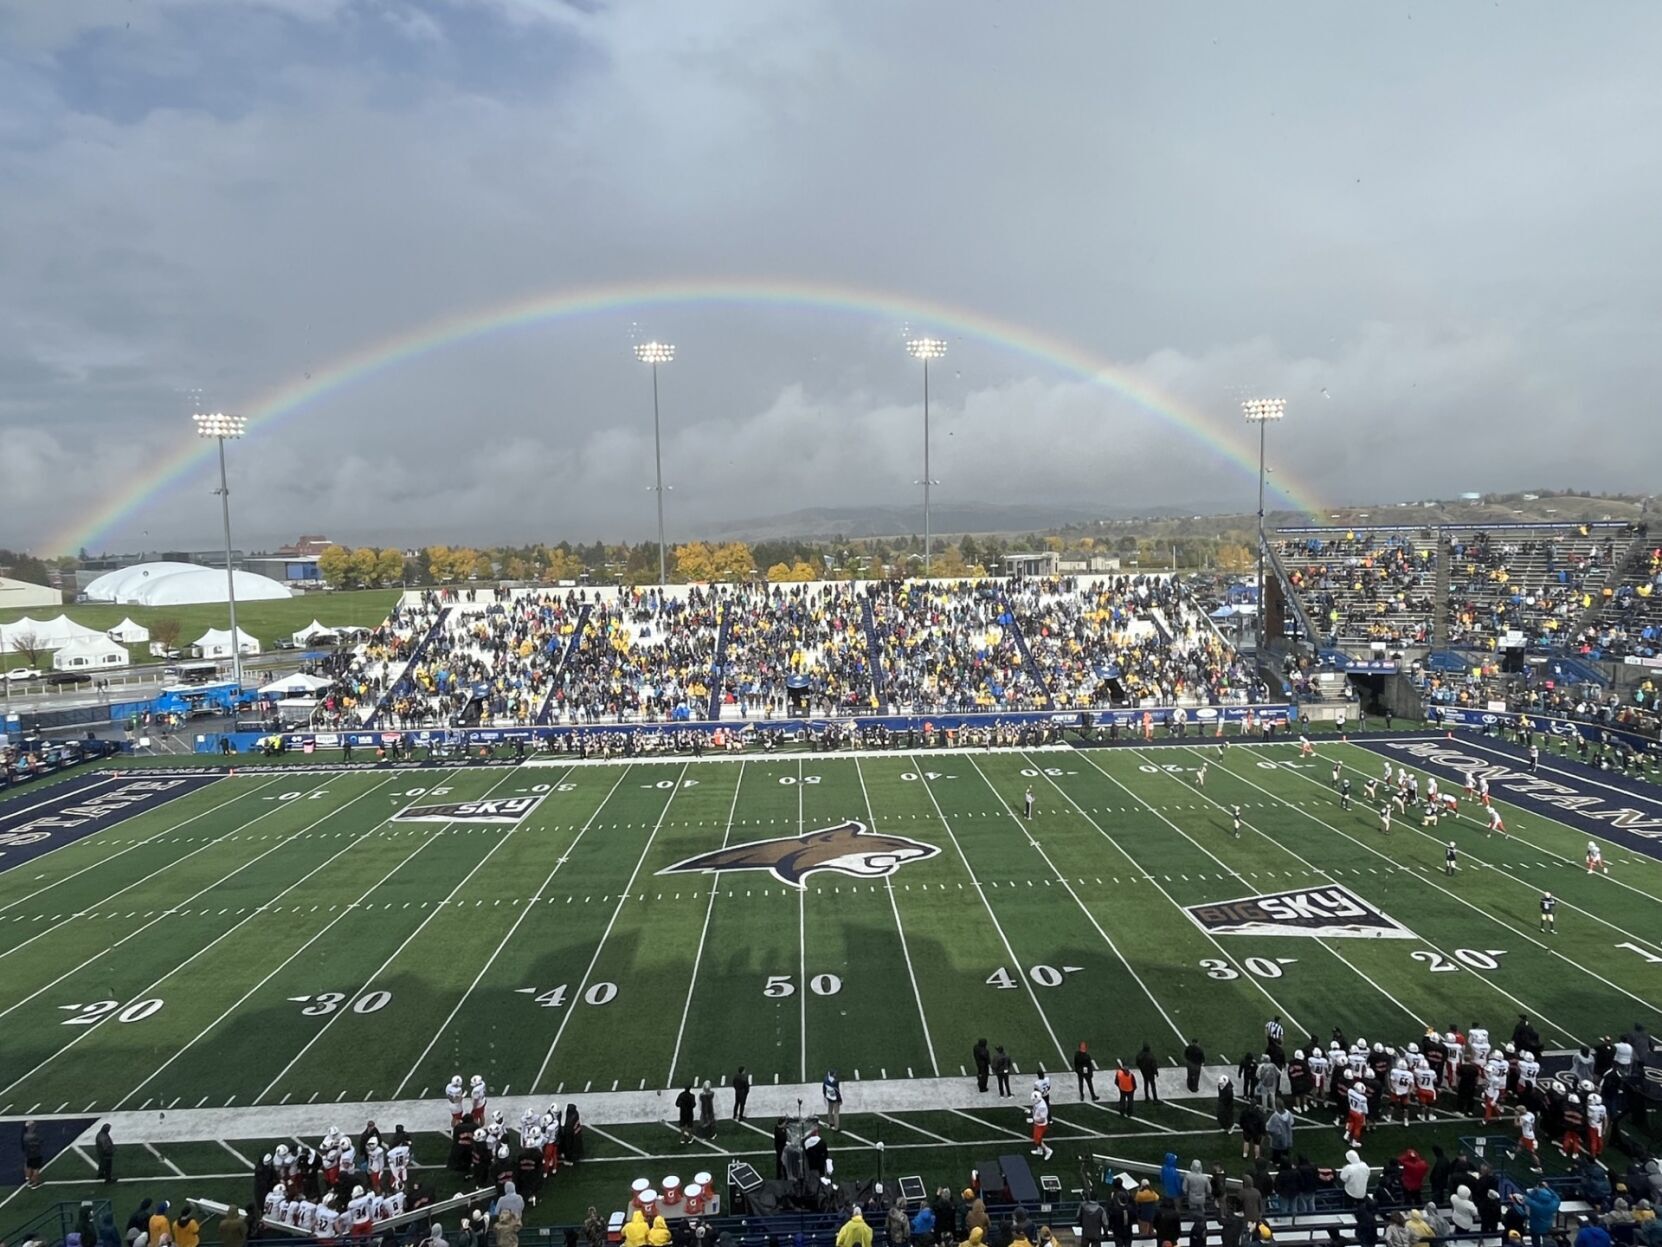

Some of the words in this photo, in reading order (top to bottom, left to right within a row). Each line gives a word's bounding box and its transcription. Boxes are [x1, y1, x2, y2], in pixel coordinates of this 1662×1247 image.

[900, 772, 942, 781] 40
[1020, 767, 1063, 778] 30
[1138, 764, 1184, 774] 20
[531, 783, 577, 793] 30
[655, 779, 700, 789] 40
[778, 776, 822, 785] 50
[405, 787, 454, 797] 20
[1386, 742, 1662, 842] MONTAN
[0, 779, 186, 846] STATE
[453, 797, 533, 815] SKY
[1196, 902, 1268, 922] BIG
[1257, 889, 1368, 920] SKY
[1199, 956, 1284, 981] 30
[1410, 947, 1500, 973] 20
[763, 973, 843, 998] 50
[985, 964, 1064, 990] 40
[302, 990, 393, 1016] 30
[533, 981, 619, 1008] 40
[61, 998, 165, 1025] 20
[1421, 1076, 1431, 1087] 77
[355, 1207, 367, 1219] 34
